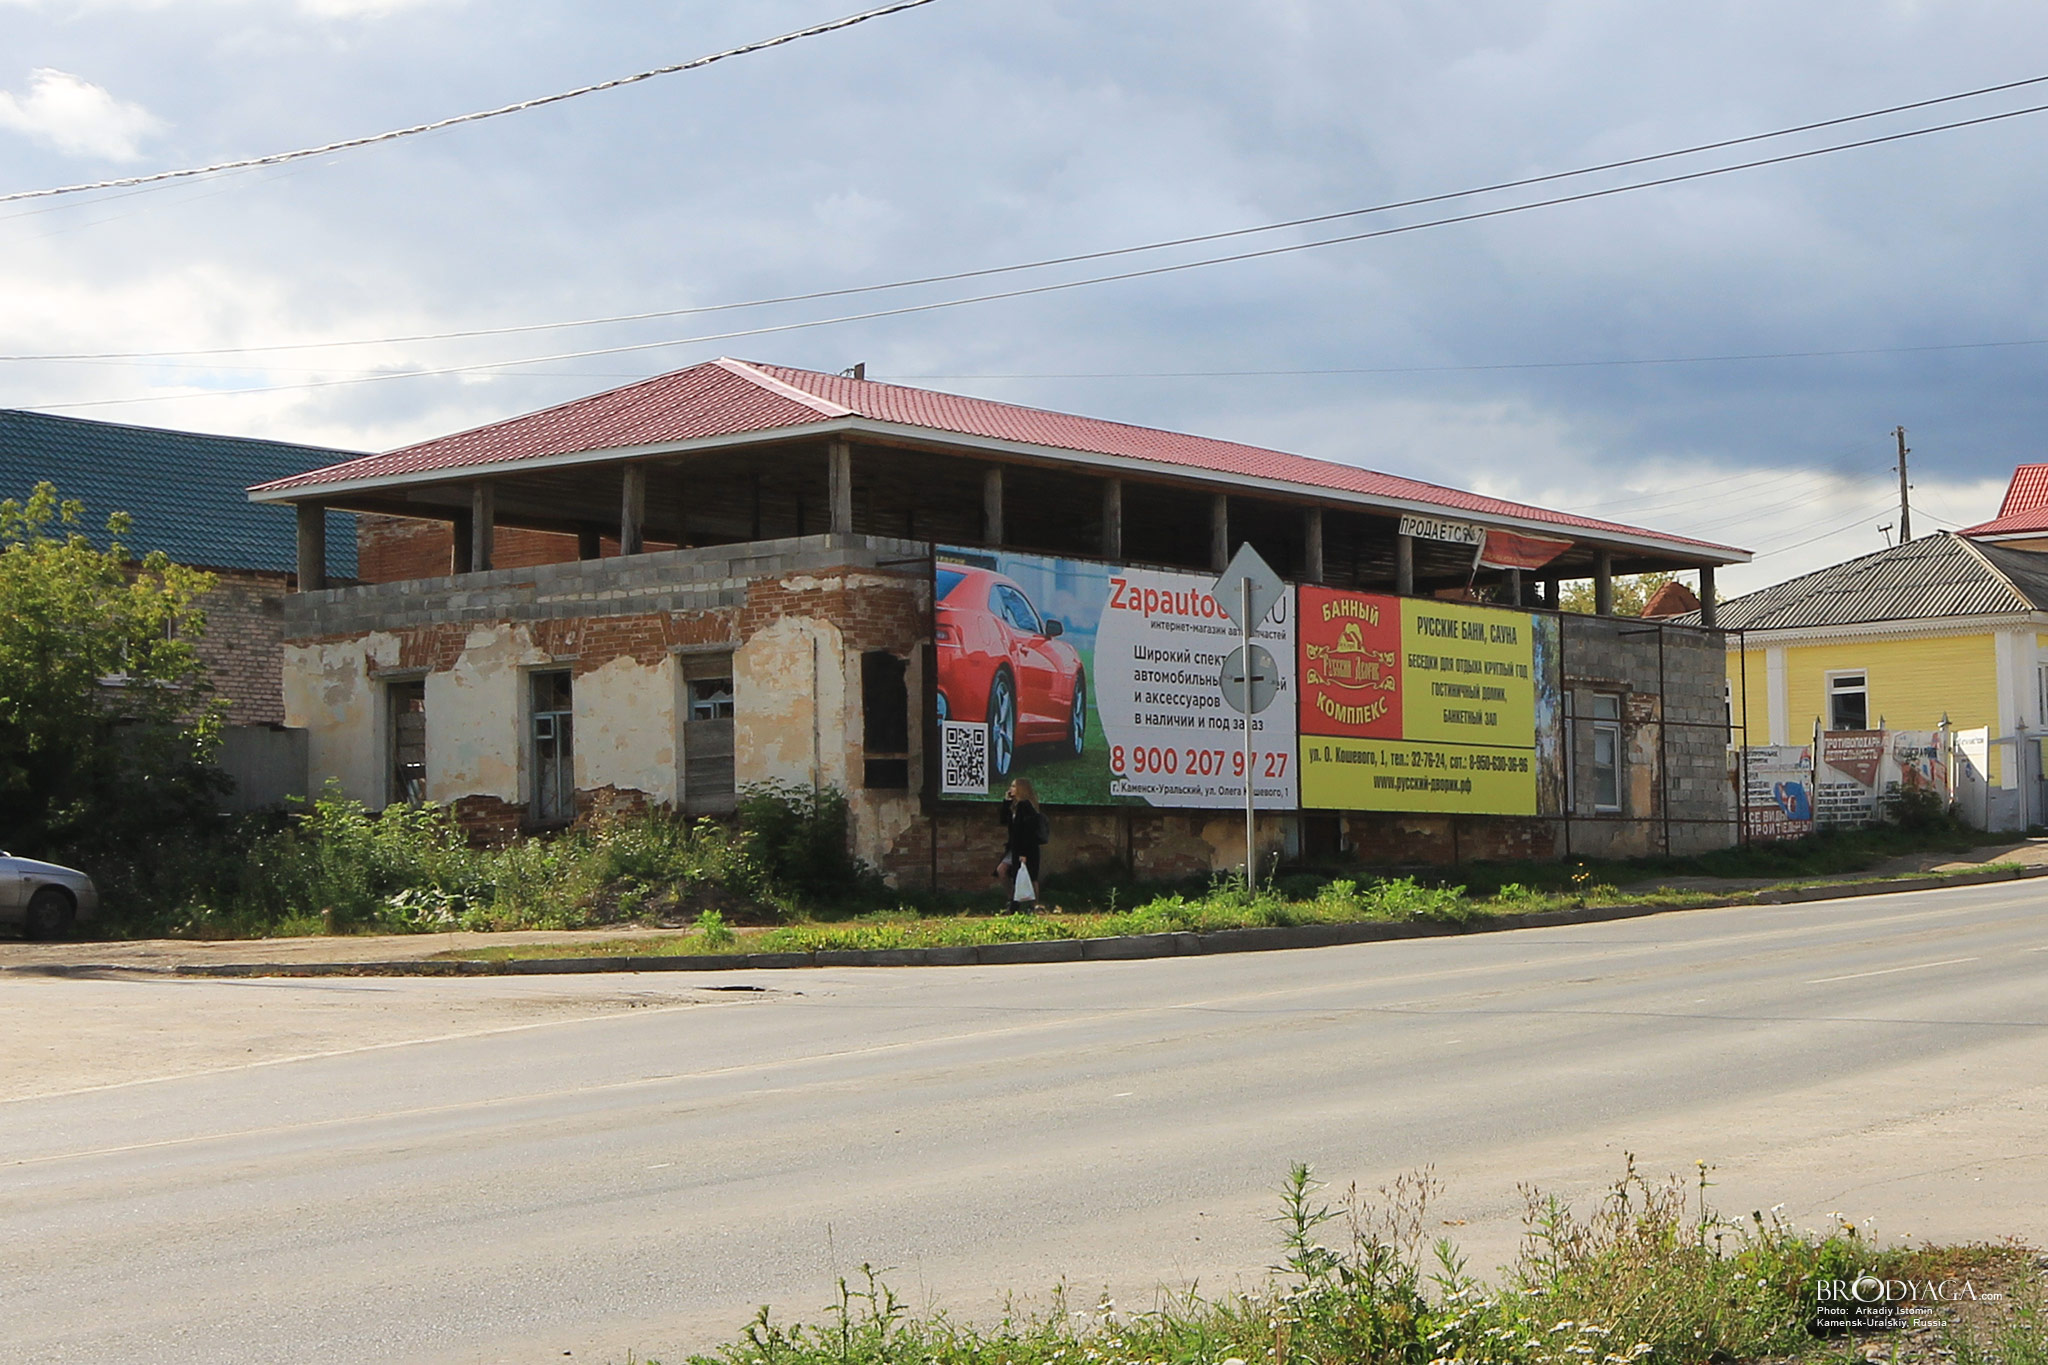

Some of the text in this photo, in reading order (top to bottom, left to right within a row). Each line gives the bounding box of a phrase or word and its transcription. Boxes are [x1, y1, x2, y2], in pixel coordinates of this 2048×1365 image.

[1400, 516, 1474, 542] ПРОДАЕТСЯ
[1322, 599, 1380, 627] БАННЫЙ
[1150, 620, 1227, 636] интернет-магазин
[1417, 616, 1518, 645] РУССКИЕ БАНИ, САУНА
[1134, 644, 1227, 667] Широкий спект
[1408, 653, 1528, 680] БЕСЕДКИ ДЛЯ ОТДЫХА КРУГЛЫЙ ГОД
[1134, 668, 1221, 687] автомобильны
[1134, 691, 1221, 709] и аксессуаров
[1431, 682, 1480, 699] ГОСТИНИЧНЫЙ
[1316, 691, 1388, 724] КОМПЛЕКС
[1443, 709, 1498, 726] БАНКЕТНЫЙ ЗАЛ
[1134, 712, 1264, 732] в наличии и под зааз
[1111, 745, 1126, 773] 8
[1133, 746, 1178, 774] 900
[1185, 749, 1225, 776] 207
[1264, 752, 1288, 778] 27
[1309, 747, 1322, 764] ул.
[1324, 746, 1333, 762] О.
[1335, 746, 1378, 767] Кошевого,
[1380, 750, 1388, 768] 1,
[1112, 784, 1120, 793] г.
[1121, 781, 1203, 796] Каменск-Уральский,
[1205, 785, 1217, 797] ул.
[1219, 786, 1242, 797] Олега
